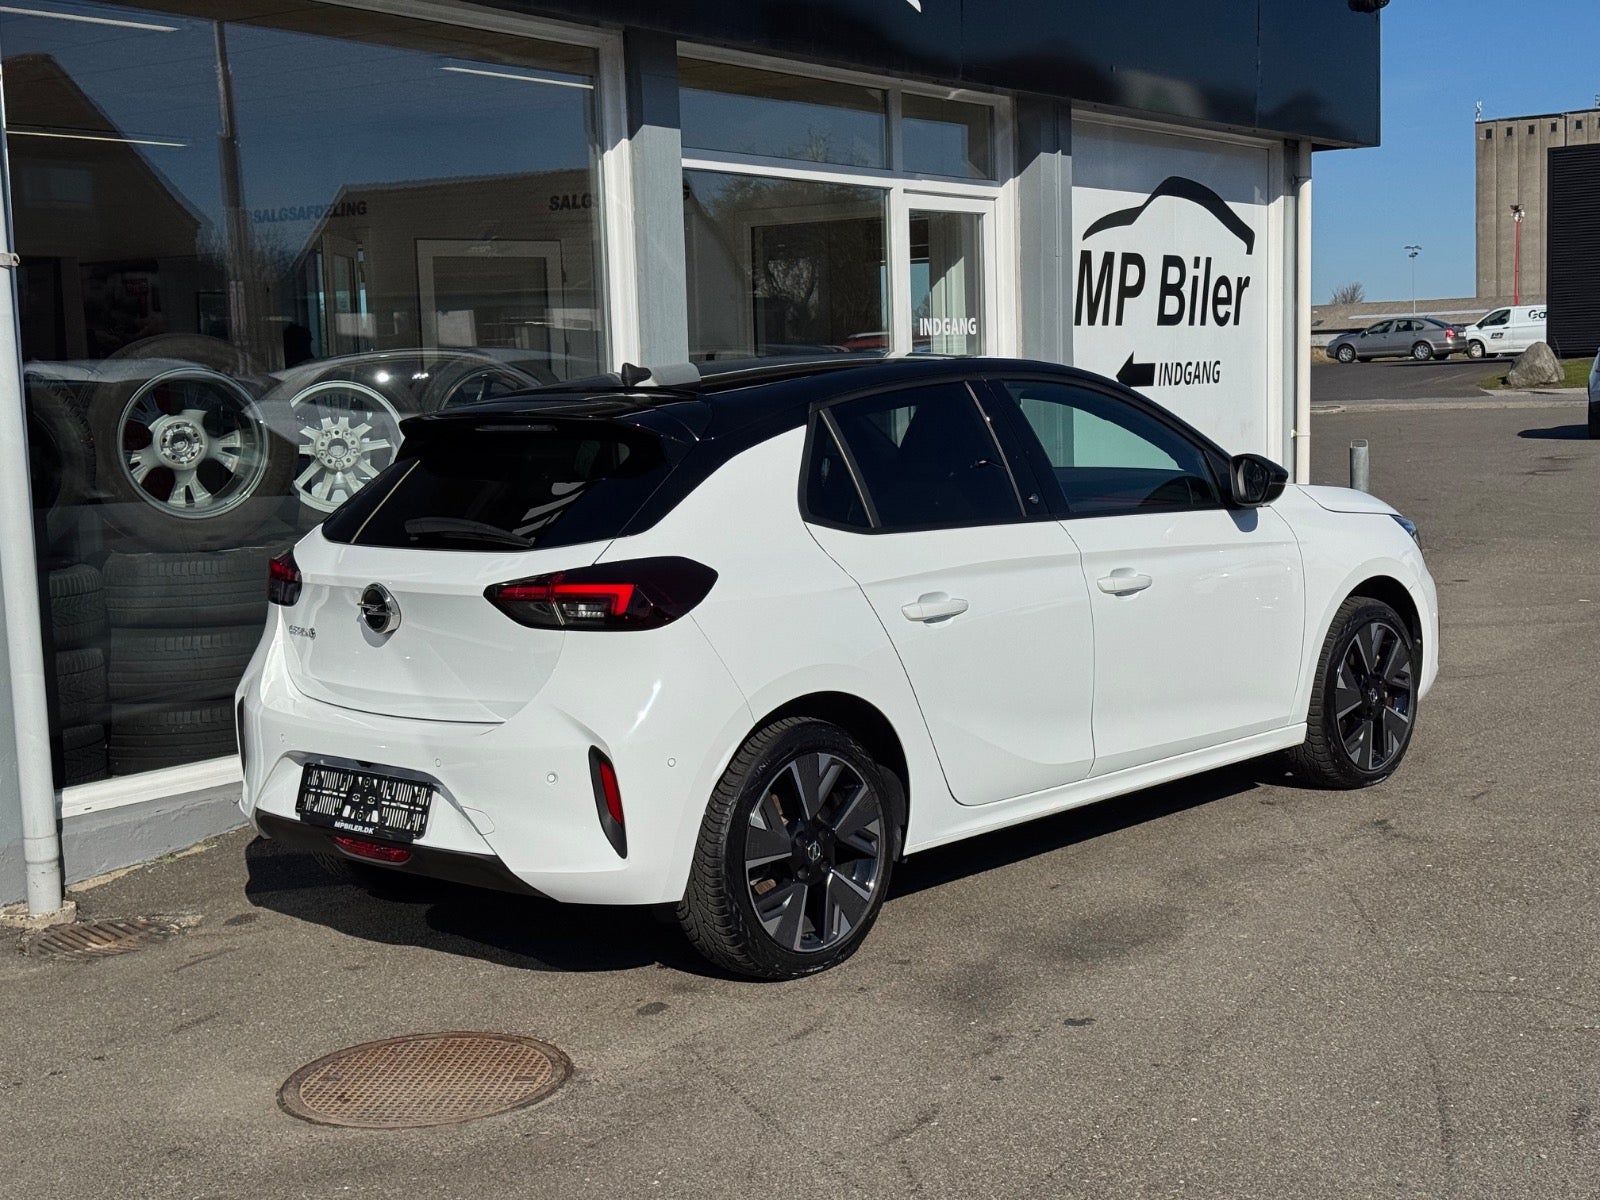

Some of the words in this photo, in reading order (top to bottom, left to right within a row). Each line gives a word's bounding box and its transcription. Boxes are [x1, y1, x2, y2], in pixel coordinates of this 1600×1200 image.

[1074, 250, 1146, 326] MP
[1157, 254, 1251, 327] Biler
[919, 317, 977, 336] INDGANG
[1158, 360, 1220, 387] INDGANG
[334, 820, 374, 835] MPBILER.DK
